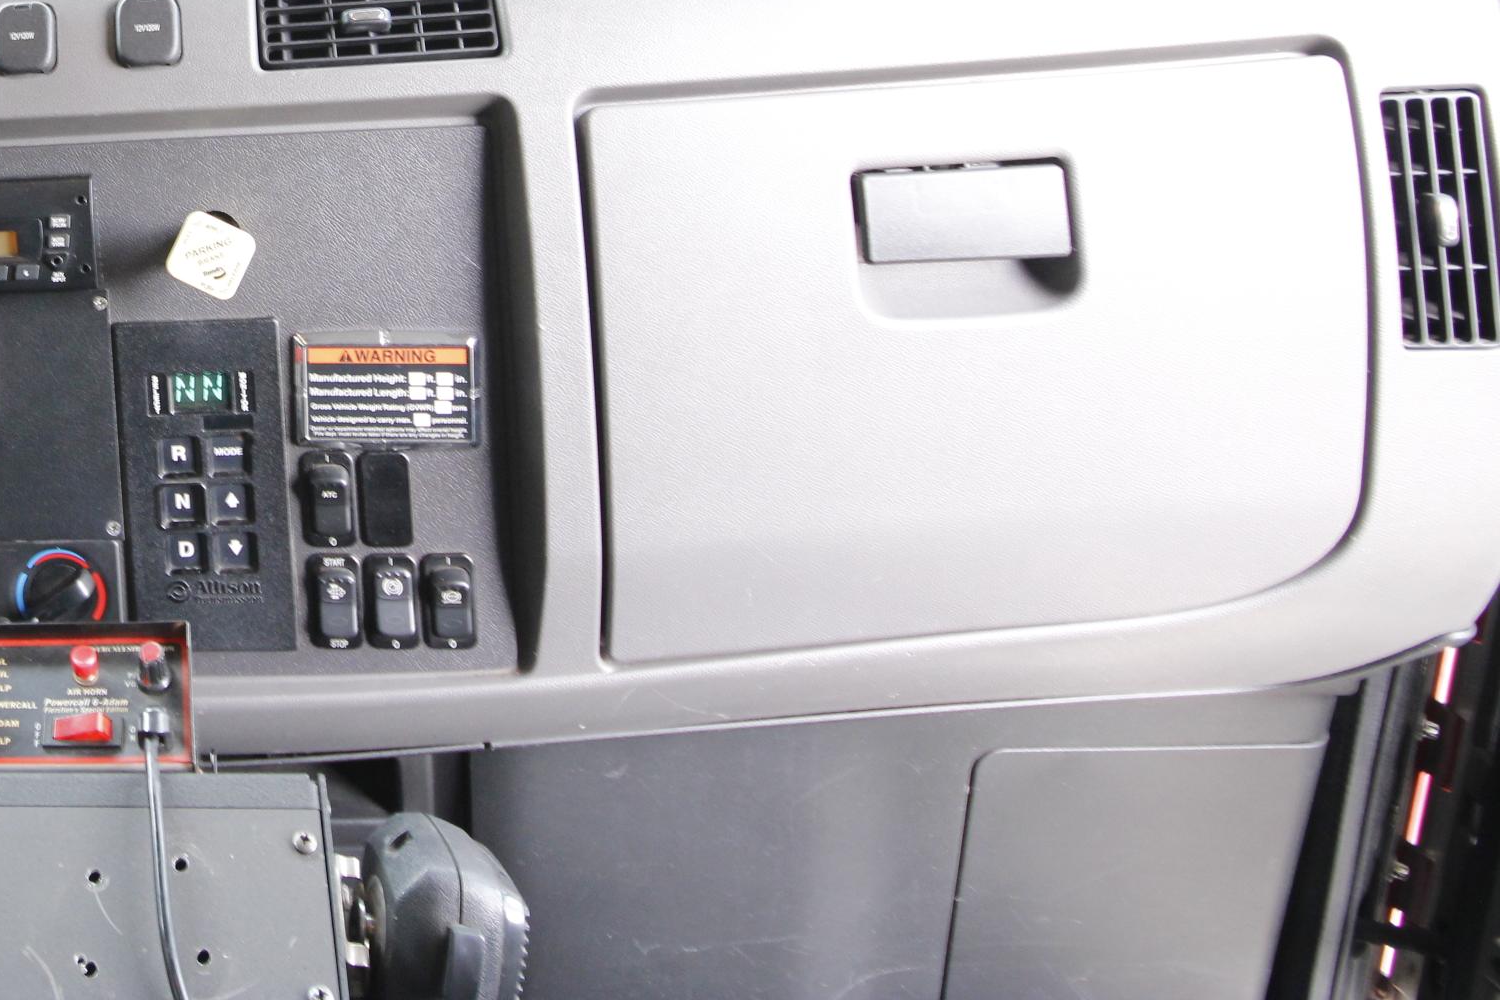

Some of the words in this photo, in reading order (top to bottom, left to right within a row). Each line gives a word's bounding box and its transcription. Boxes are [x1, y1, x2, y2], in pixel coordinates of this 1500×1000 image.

[355, 350, 436, 363] WARNING
[308, 372, 373, 384] Manufactured
[308, 386, 373, 397] Manufactured
[310, 402, 332, 411] Gross
[331, 402, 357, 411] Vehicle
[357, 402, 383, 413] Weight
[170, 445, 187, 462] R
[213, 447, 244, 456] MODE
[174, 493, 191, 511] N
[178, 541, 195, 558] D
[323, 557, 345, 567] START
[197, 580, 263, 596] Allison
[329, 638, 349, 649] STOP
[66, 687, 82, 696] AIR
[83, 687, 109, 696] HORN
[43, 698, 91, 707] Powercall
